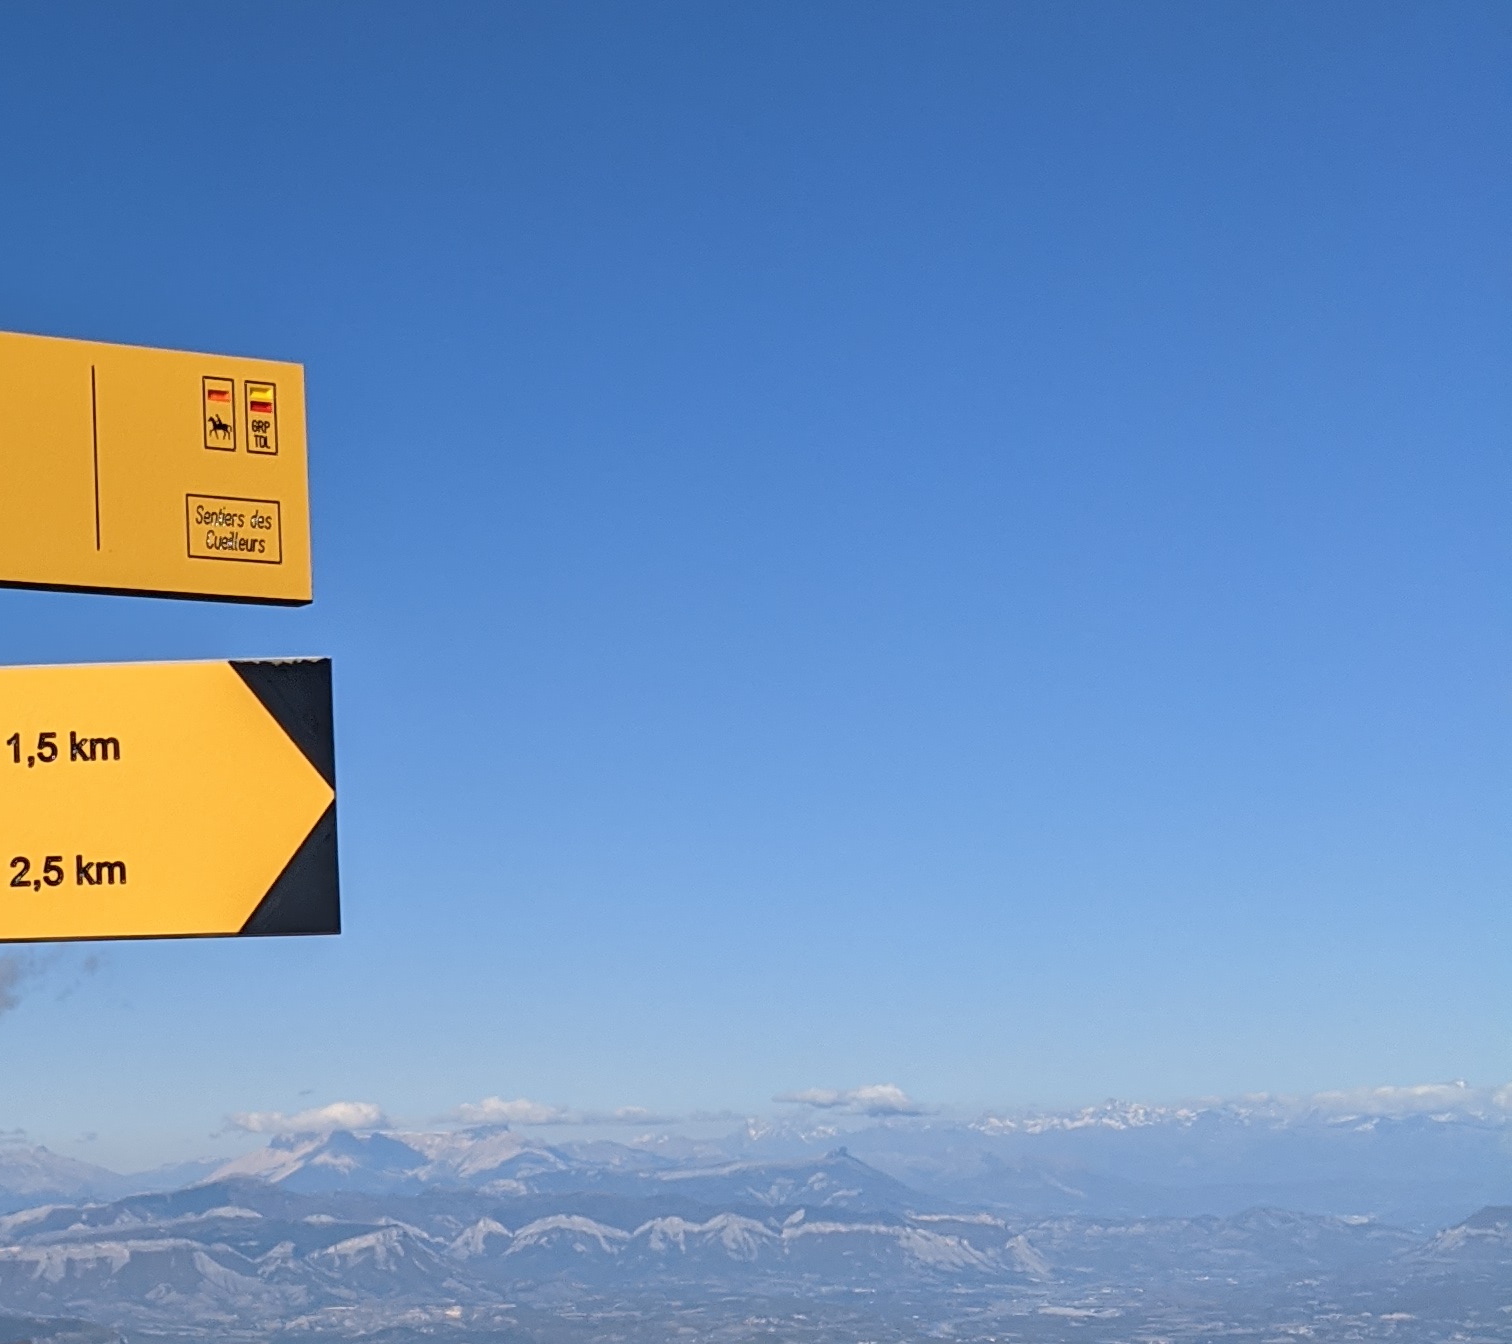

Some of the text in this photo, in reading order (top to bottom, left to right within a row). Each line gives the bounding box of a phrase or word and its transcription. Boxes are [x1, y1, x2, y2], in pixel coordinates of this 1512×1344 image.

[195, 504, 273, 530] Sentiers des
[7, 732, 58, 768] 1,5
[69, 731, 121, 762] km
[10, 855, 64, 892] 2,5
[75, 855, 127, 886] km
